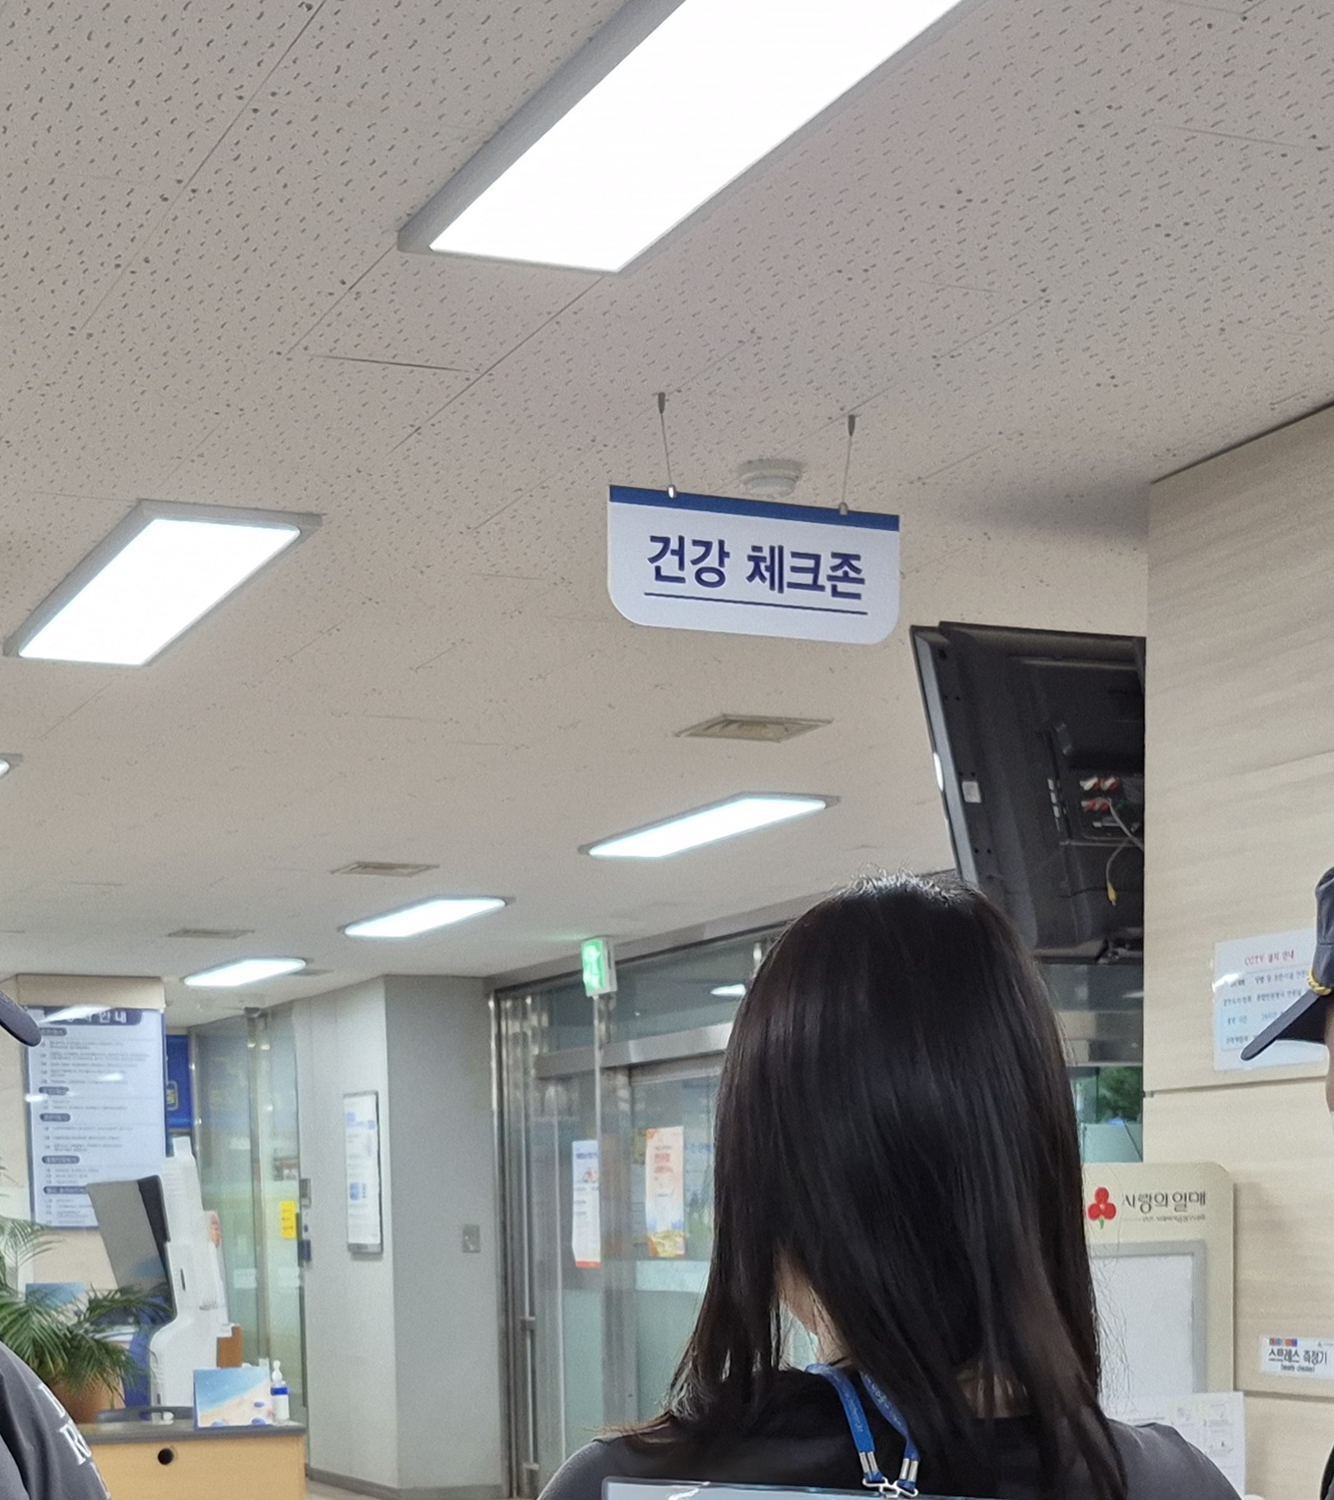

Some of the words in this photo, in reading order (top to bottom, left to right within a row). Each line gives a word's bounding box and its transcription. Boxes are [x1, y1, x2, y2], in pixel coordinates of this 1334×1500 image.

[647, 535, 731, 588] 건강
[746, 545, 866, 601] 체크존
[1268, 1348, 1300, 1364] 스트레스
